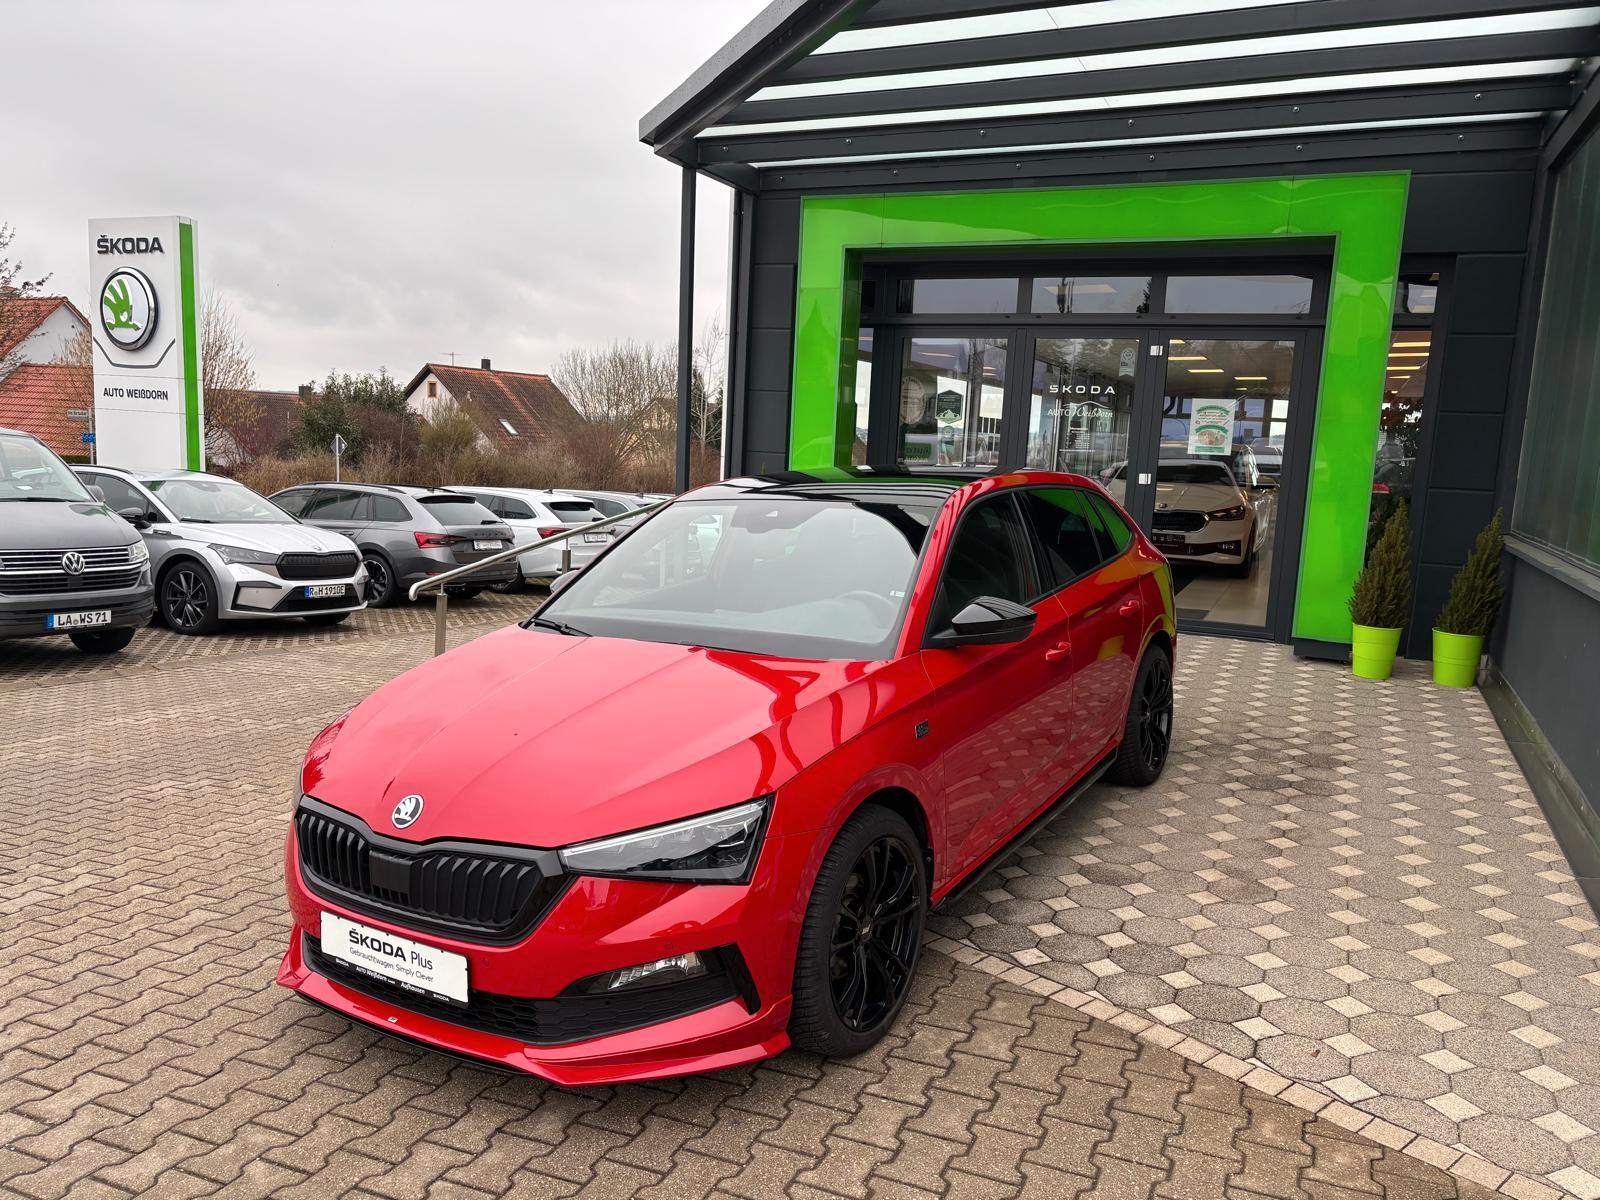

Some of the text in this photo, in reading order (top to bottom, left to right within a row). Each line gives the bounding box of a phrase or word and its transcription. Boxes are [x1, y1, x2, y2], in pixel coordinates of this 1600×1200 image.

[96, 234, 164, 255] ŠKODA
[103, 387, 169, 401] AUTO WEIßDORN
[1047, 408, 1071, 417] AUTO
[309, 587, 315, 596] R
[318, 586, 324, 595] H
[57, 611, 108, 626] LA WS 71
[349, 928, 433, 970] ŠKODA Plus
[395, 964, 415, 978] Simply
[415, 970, 434, 982] Clever
